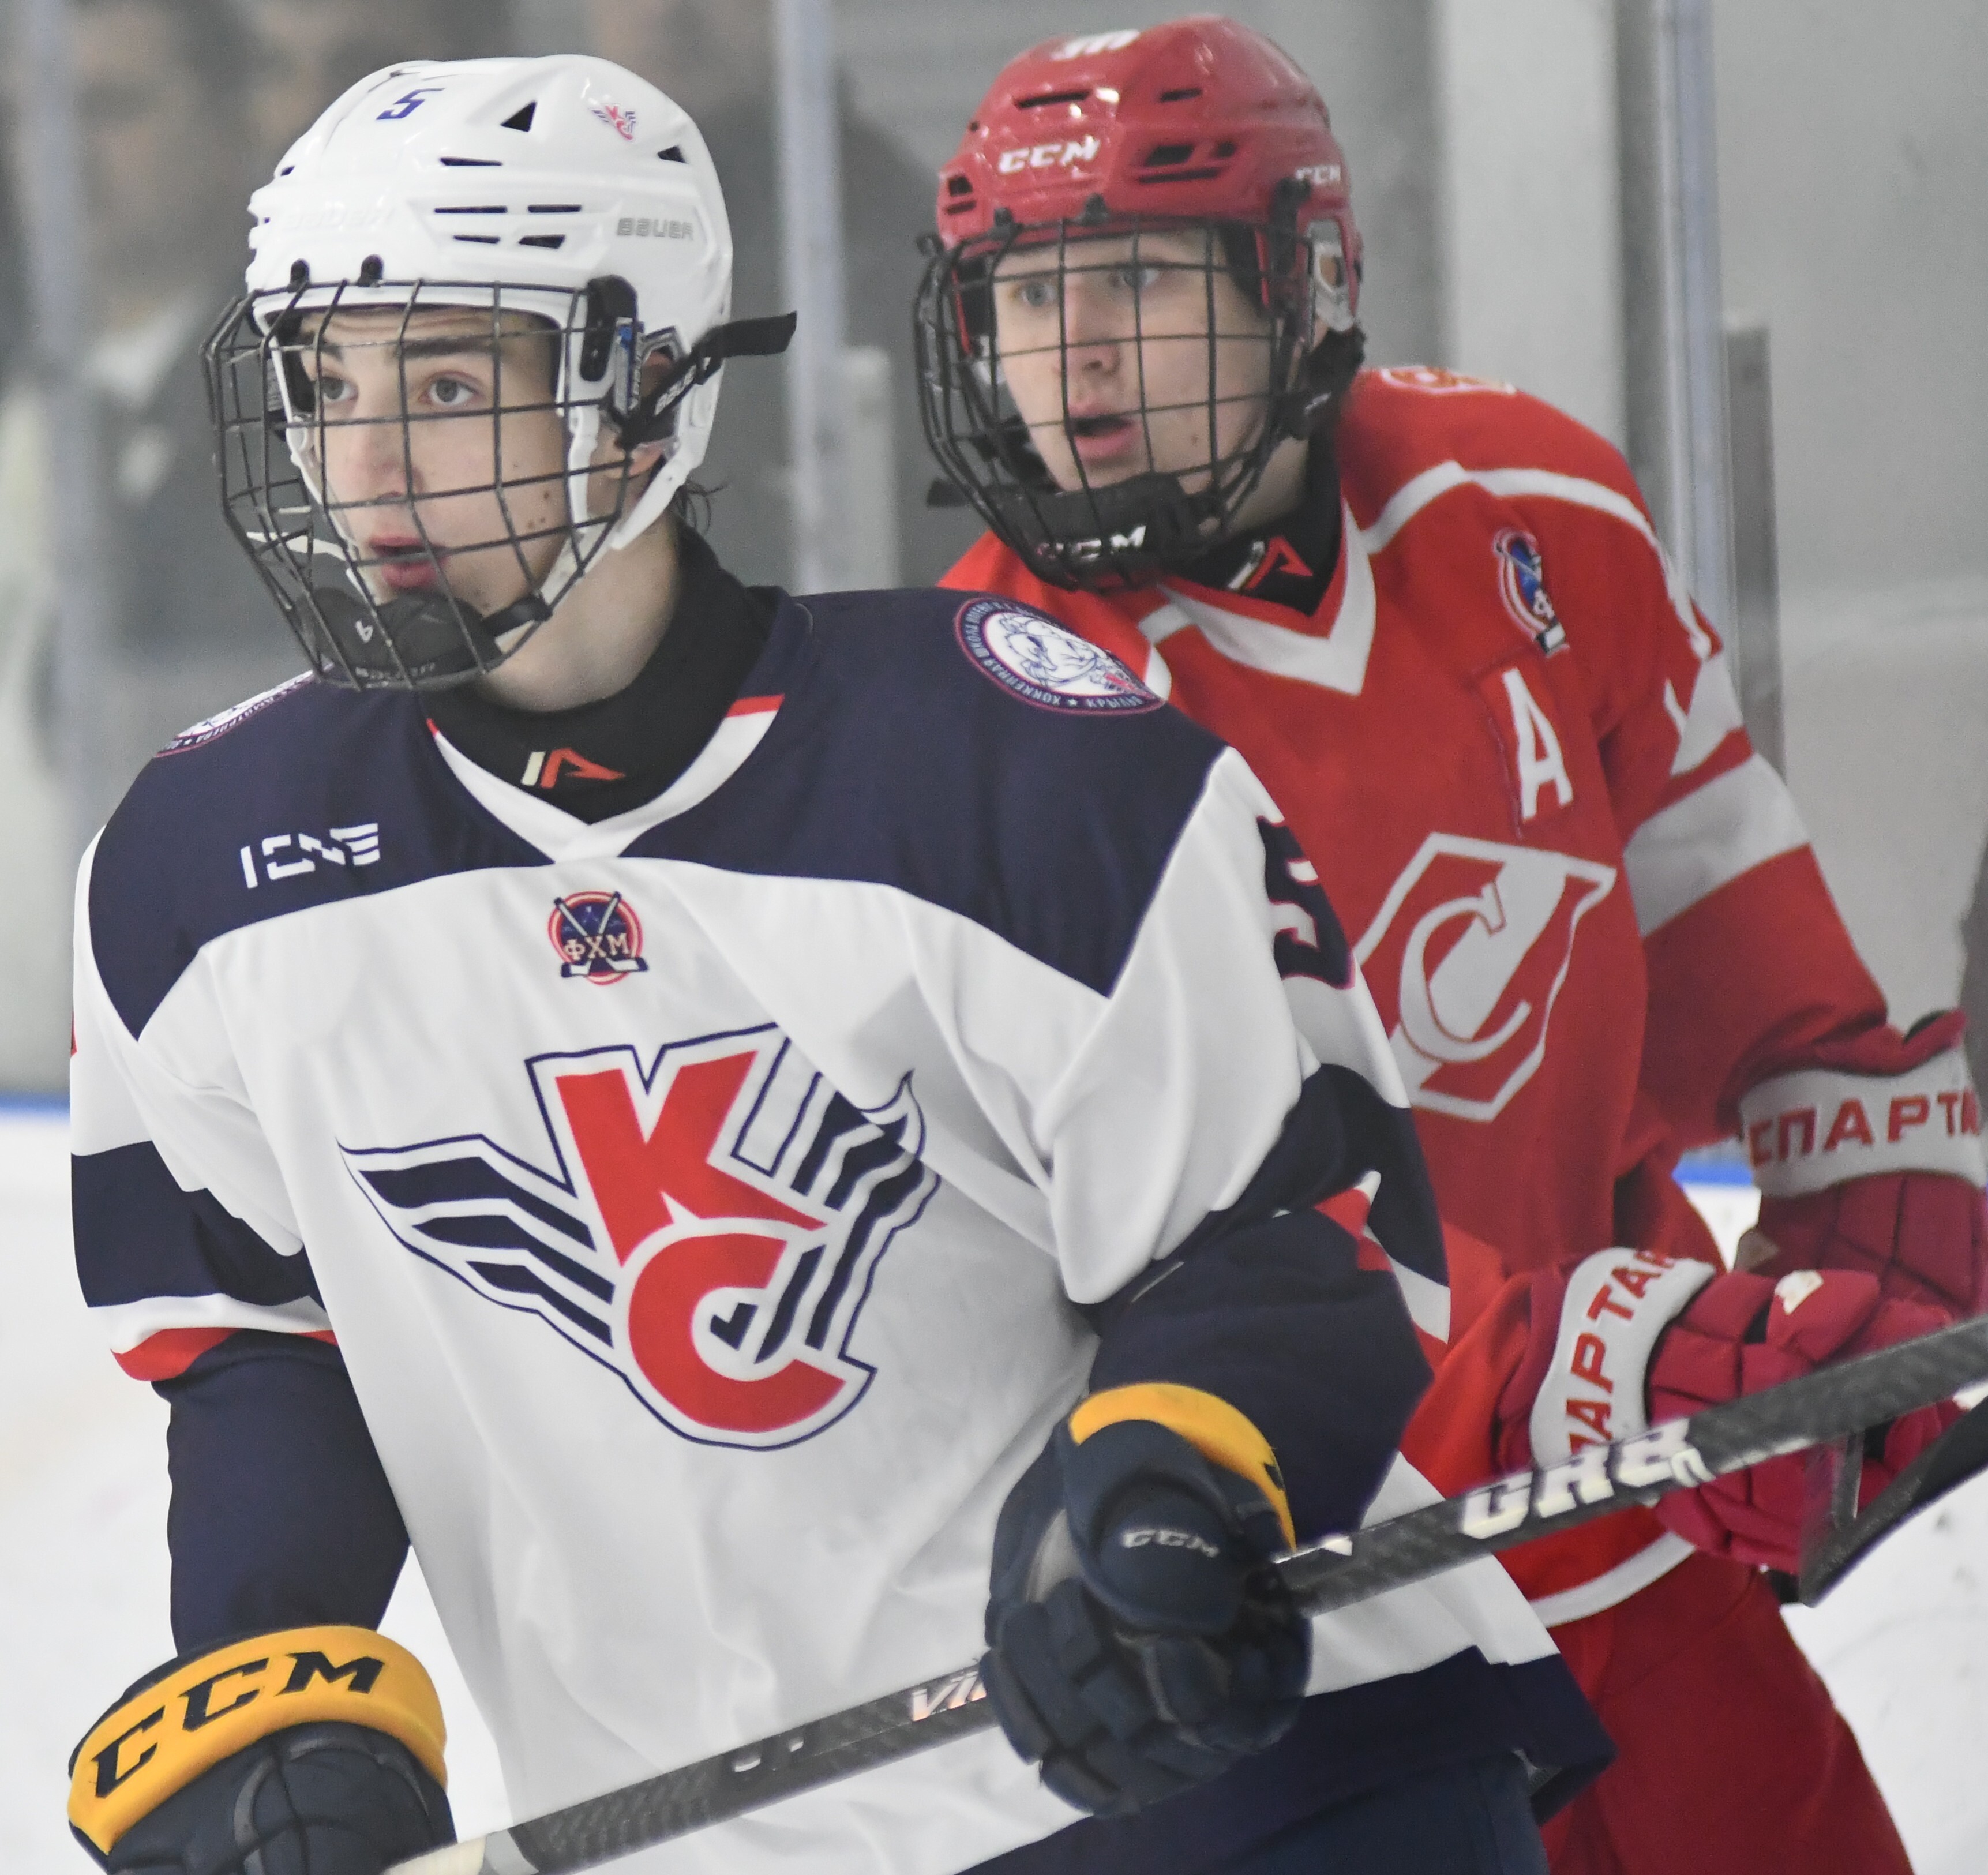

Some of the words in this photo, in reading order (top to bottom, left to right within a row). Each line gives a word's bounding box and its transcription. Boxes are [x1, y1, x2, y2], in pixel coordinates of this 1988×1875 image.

[376, 87, 447, 119] 5
[999, 134, 1100, 173] CCM
[617, 217, 694, 240] BAUER
[1566, 1250, 1674, 1455] АРТА
[1121, 1529, 1220, 1558] CCM
[90, 1651, 385, 1799] CCM
